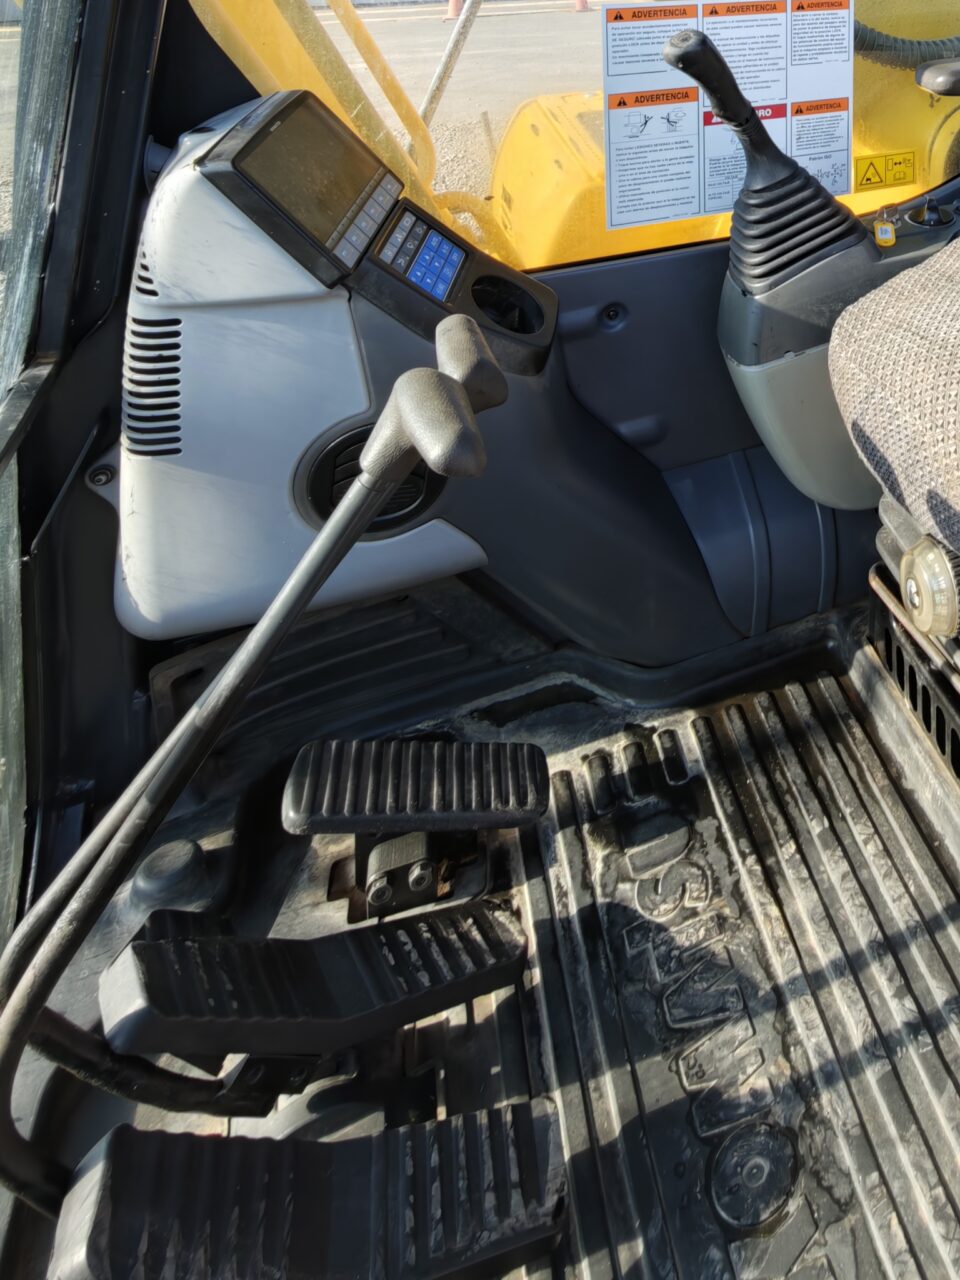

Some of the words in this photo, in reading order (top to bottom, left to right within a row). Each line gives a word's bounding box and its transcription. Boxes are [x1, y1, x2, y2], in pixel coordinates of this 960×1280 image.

[725, 3, 777, 14] ADVERTENCIA
[806, 1, 843, 9] ADVERTENCIA
[631, 8, 688, 19] ADVERTENCIA
[634, 91, 690, 104] ADVERTENCIA
[805, 102, 842, 112] ADVERTENCIA
